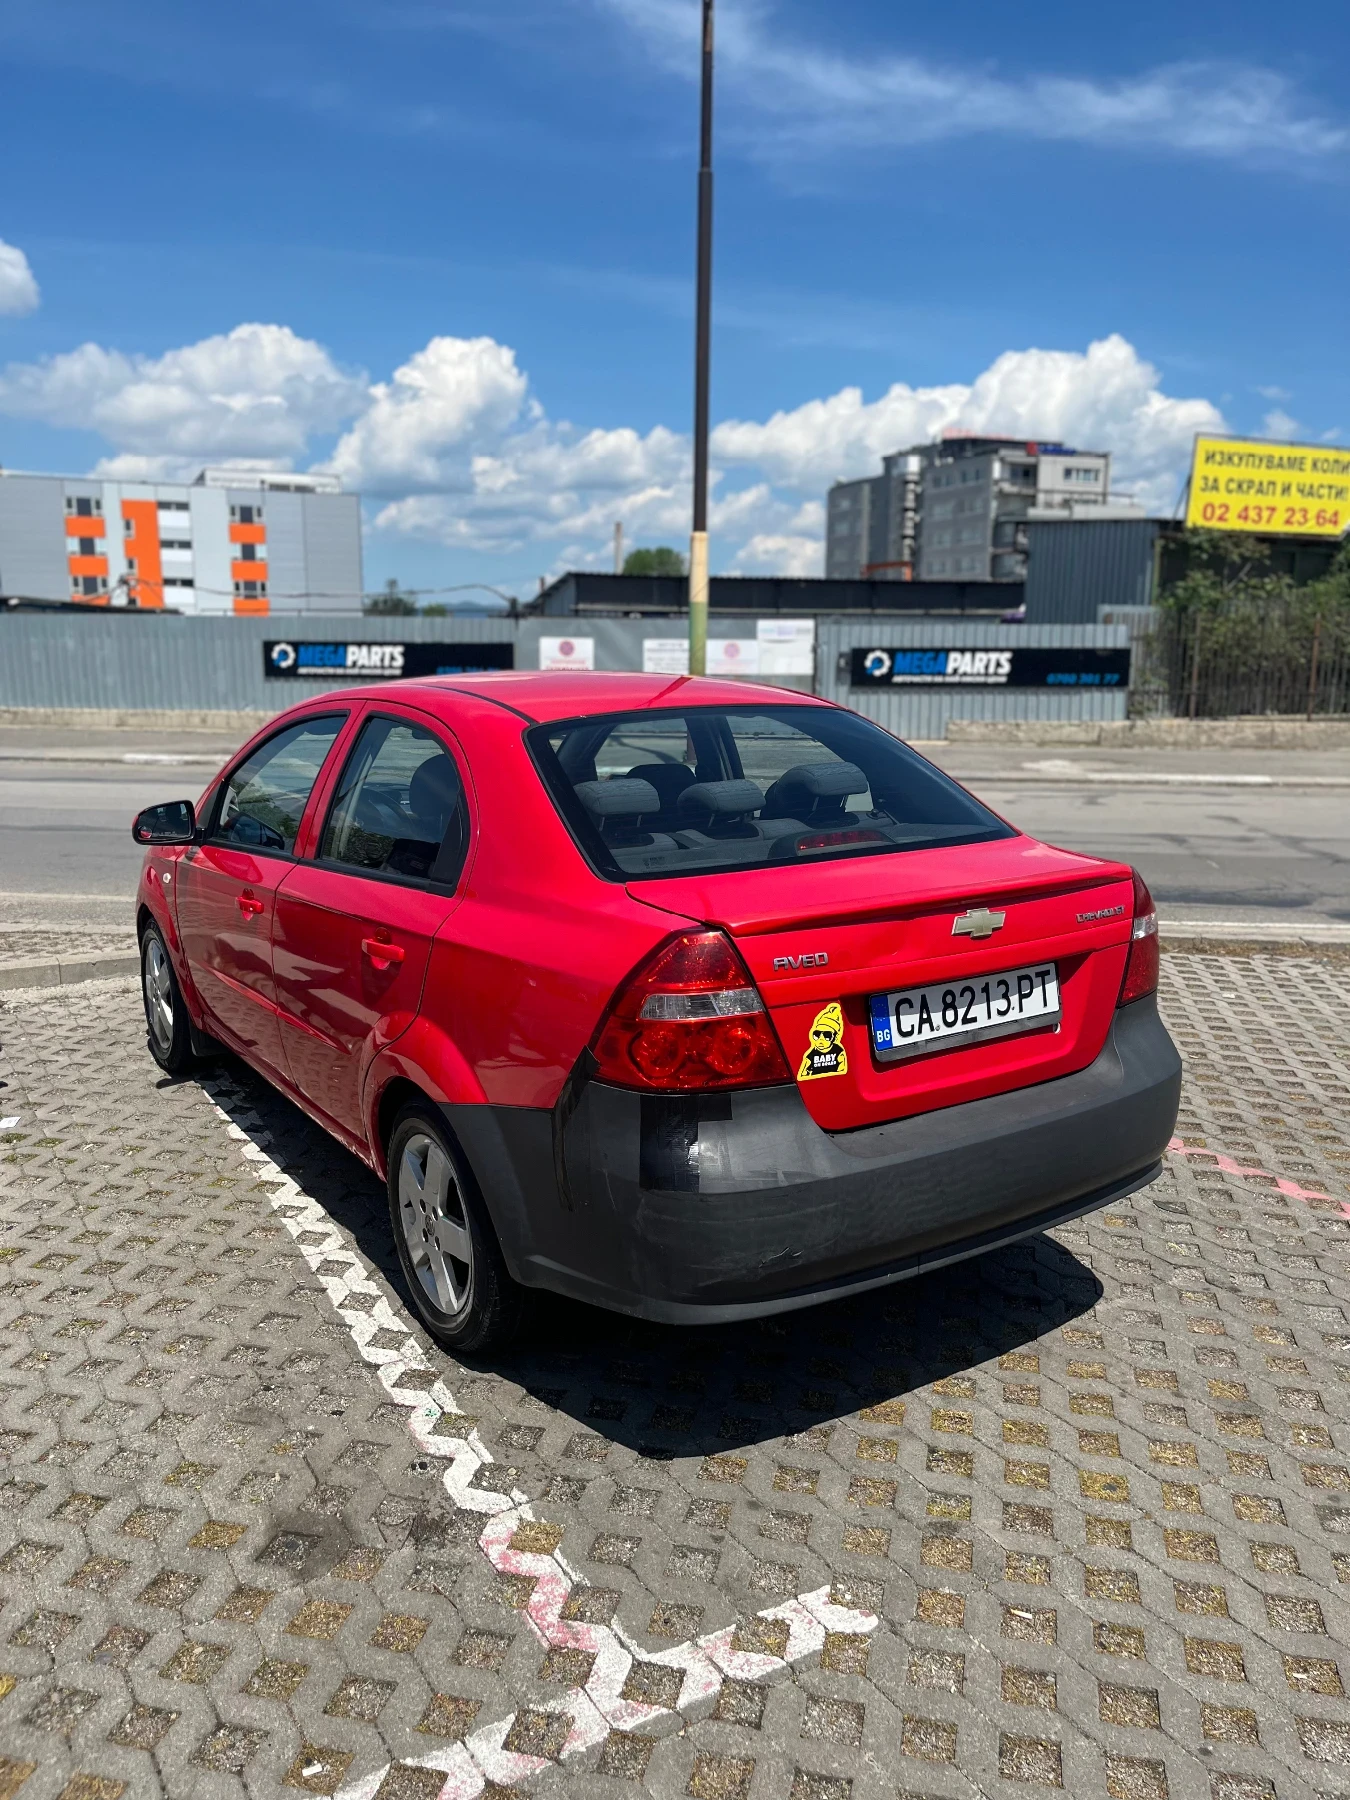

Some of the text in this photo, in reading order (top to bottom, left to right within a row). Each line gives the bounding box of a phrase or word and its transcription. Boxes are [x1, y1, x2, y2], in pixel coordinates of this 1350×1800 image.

[1204, 449, 1307, 472] ИЗКУПУВАМЕ
[1200, 475, 1220, 493] ЗА
[1225, 477, 1277, 496] СКРАП
[1281, 482, 1291, 498] И
[1202, 502, 1339, 527] 02 437 23 64
[773, 952, 829, 971] AVEO
[876, 1028, 891, 1043] BG
[813, 1053, 837, 1064] BABY
